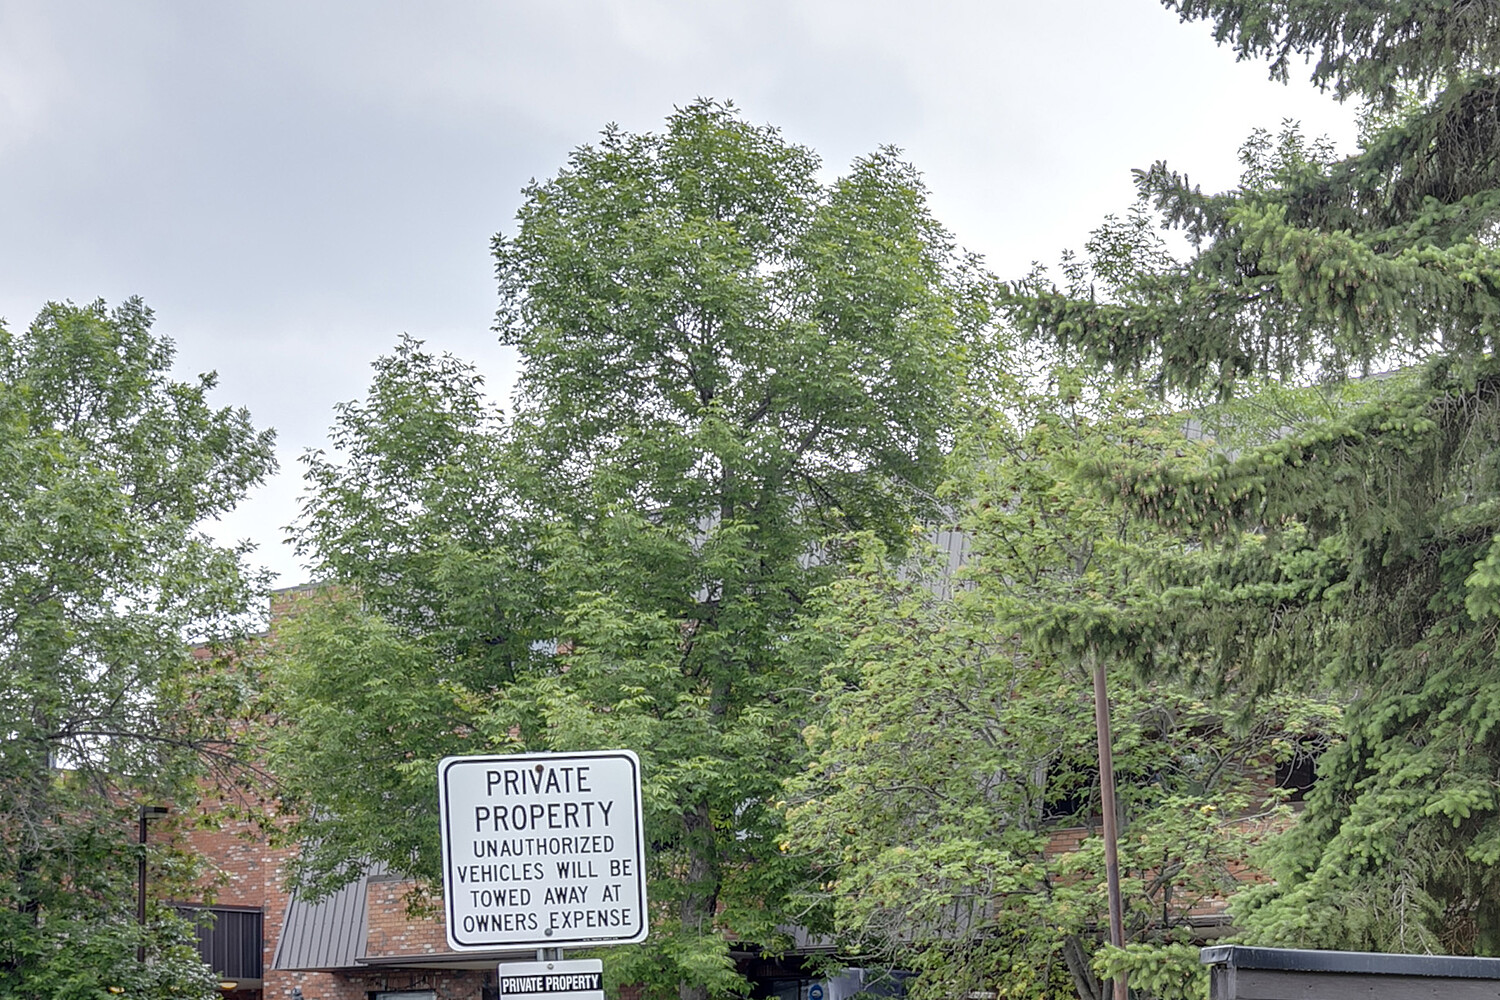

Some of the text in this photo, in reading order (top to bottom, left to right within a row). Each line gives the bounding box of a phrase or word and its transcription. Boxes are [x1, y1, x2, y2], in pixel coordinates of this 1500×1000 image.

[486, 766, 592, 797] PRIVATE
[475, 801, 614, 833] PROPERTY
[473, 835, 615, 858] UNAUTHORIZED
[457, 859, 633, 884] VEHICLES WILL BE
[470, 884, 622, 908] TOWED AWAY AT
[463, 908, 632, 933] OWNERS EXPENSE
[502, 974, 599, 993] PRIVATE PROPERTY
